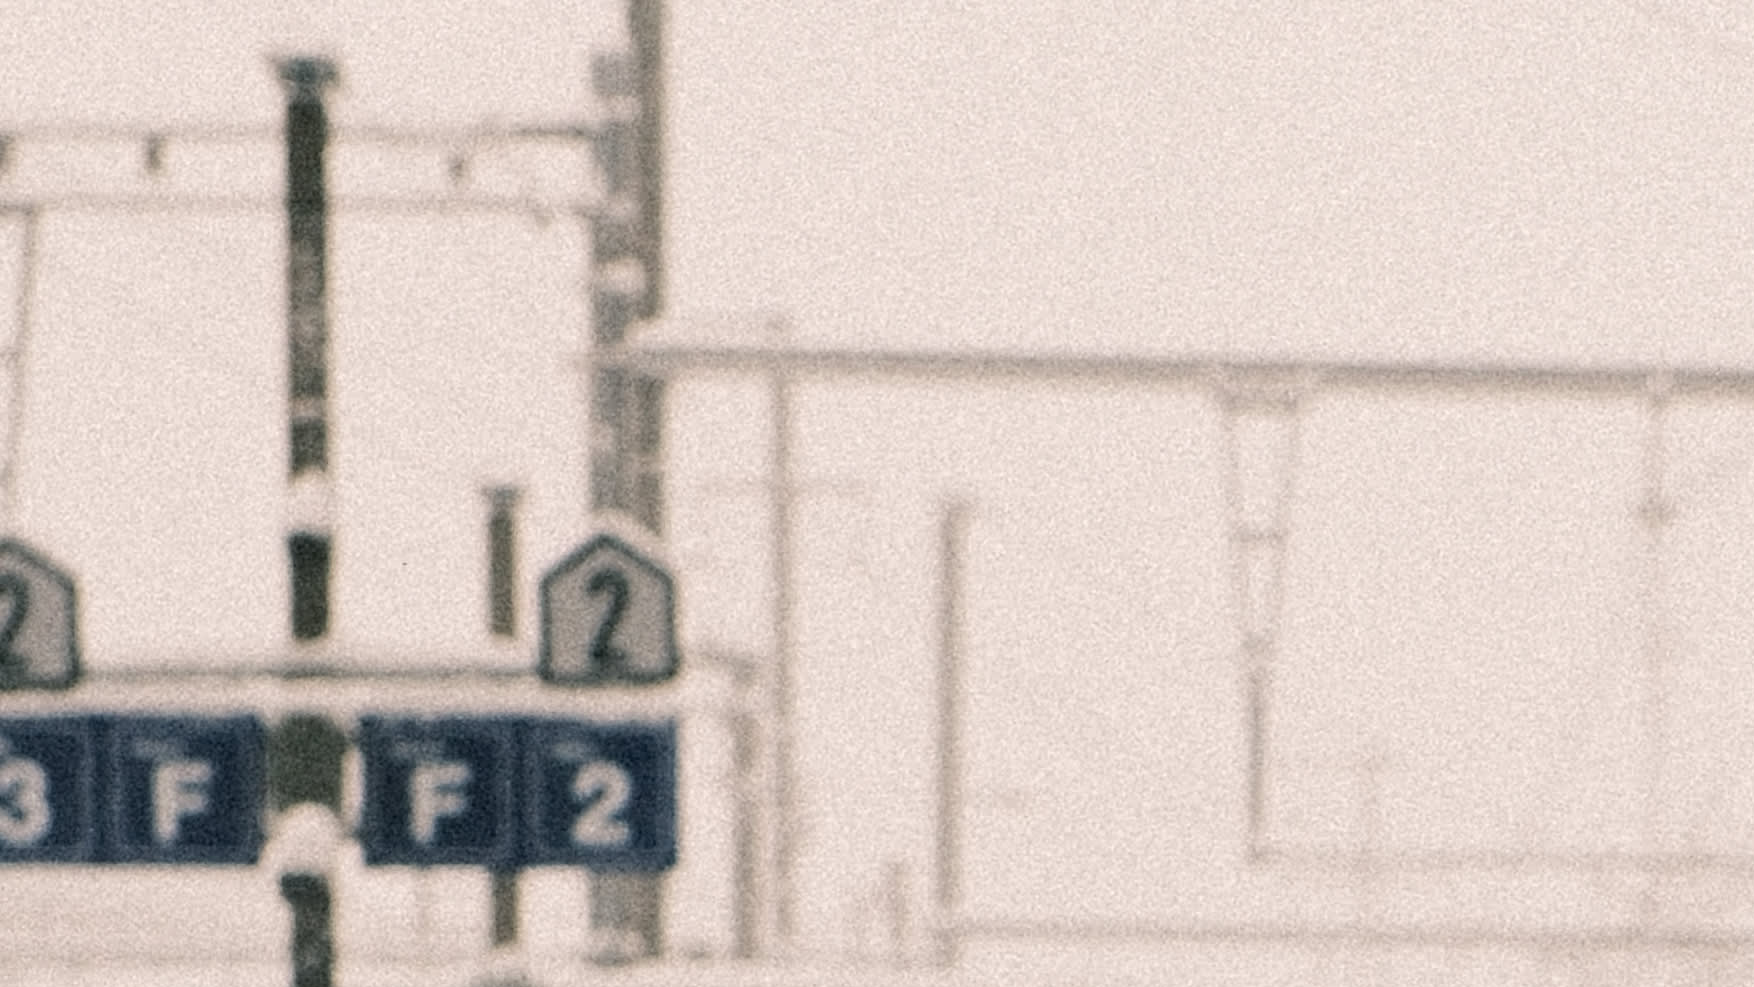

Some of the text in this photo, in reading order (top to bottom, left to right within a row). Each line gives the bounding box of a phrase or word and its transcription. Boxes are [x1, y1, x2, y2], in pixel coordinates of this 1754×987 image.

[586, 567, 630, 671] 2
[152, 761, 211, 843] F
[410, 761, 631, 846] F 2
